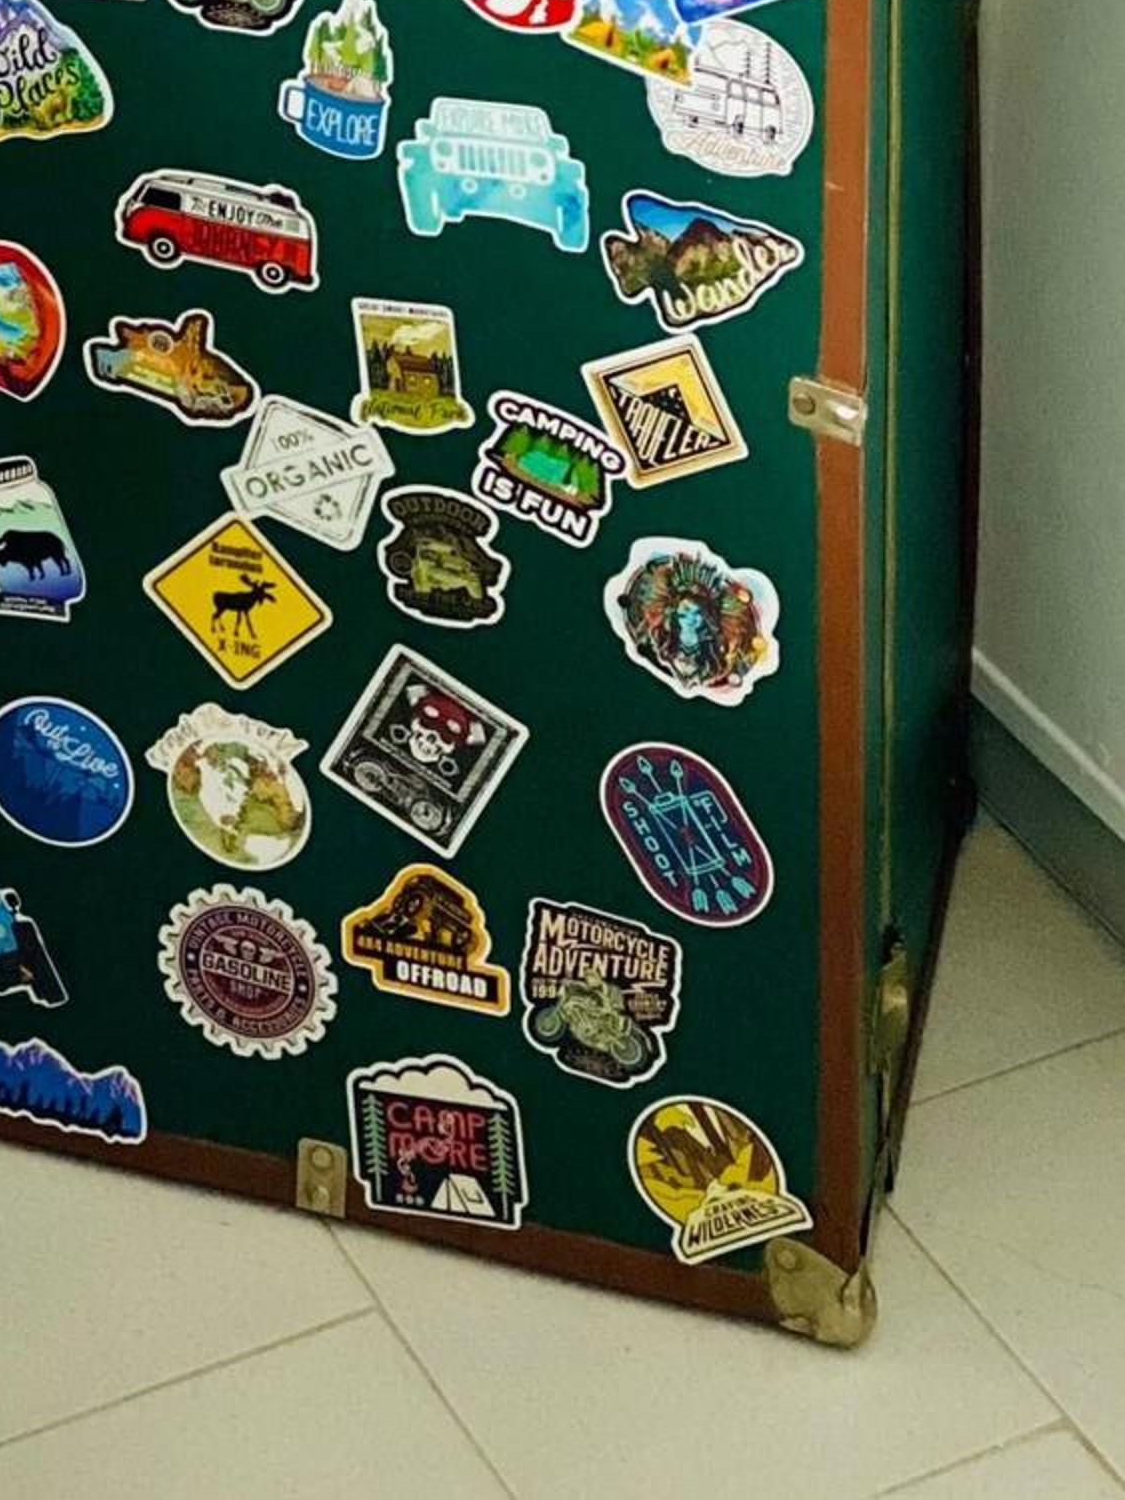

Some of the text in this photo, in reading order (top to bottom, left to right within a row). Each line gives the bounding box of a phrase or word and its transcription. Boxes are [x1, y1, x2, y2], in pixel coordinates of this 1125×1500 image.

[306, 97, 378, 146] EXPLORE
[208, 200, 254, 224] ENJOY
[662, 231, 798, 322] Wander
[499, 400, 622, 472] CAMPING
[245, 444, 373, 499] ORGANIC
[391, 498, 488, 532] OUTDOOR
[483, 472, 588, 538] IS FUN
[623, 801, 678, 888] SHOOT
[700, 797, 752, 867] FILM
[539, 908, 670, 965] MOTORCYCLE
[203, 953, 292, 991] GASOLINE
[396, 959, 488, 999] OFFROAD
[532, 943, 668, 982] ADVENTURE
[386, 1101, 486, 1141] CAMP
[388, 1130, 488, 1172] MORE
[687, 1198, 779, 1248] WILDERNESS
